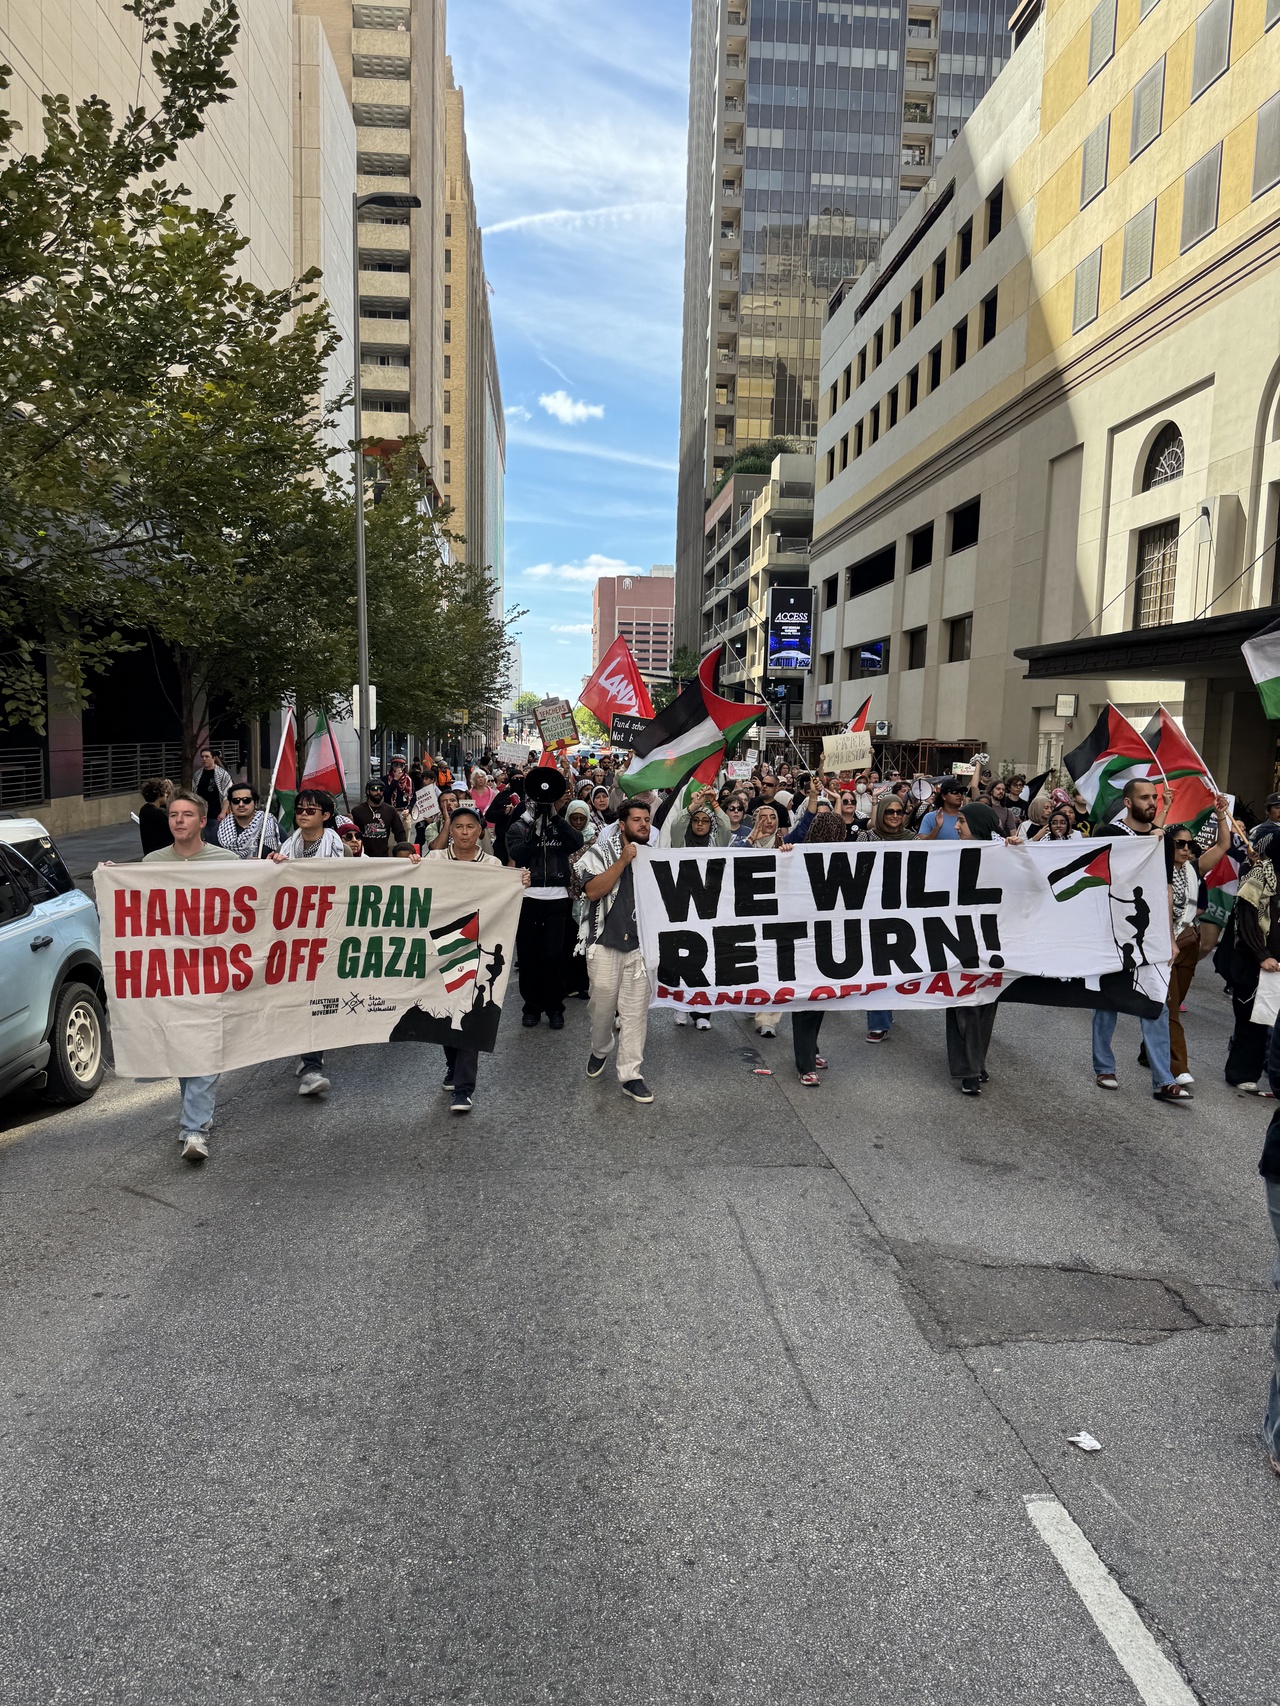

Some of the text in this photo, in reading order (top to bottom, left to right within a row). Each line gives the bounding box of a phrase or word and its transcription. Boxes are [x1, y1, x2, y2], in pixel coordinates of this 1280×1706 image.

[775, 612, 808, 621] ACCESS
[540, 705, 566, 717] TEACHERS
[547, 715, 562, 724] FOR
[613, 718, 629, 729] Fund
[612, 731, 624, 741] Not
[835, 735, 866, 751] FREE
[419, 803, 435, 815] ESTINE
[650, 848, 1003, 923] WE WILL
[114, 885, 433, 937] HANDS OFF IRAN
[657, 914, 1005, 988] RETURN!
[114, 936, 427, 998] HANDS OFF GAZA
[657, 983, 795, 1006] HANDS
[895, 972, 1004, 997] GAZA
